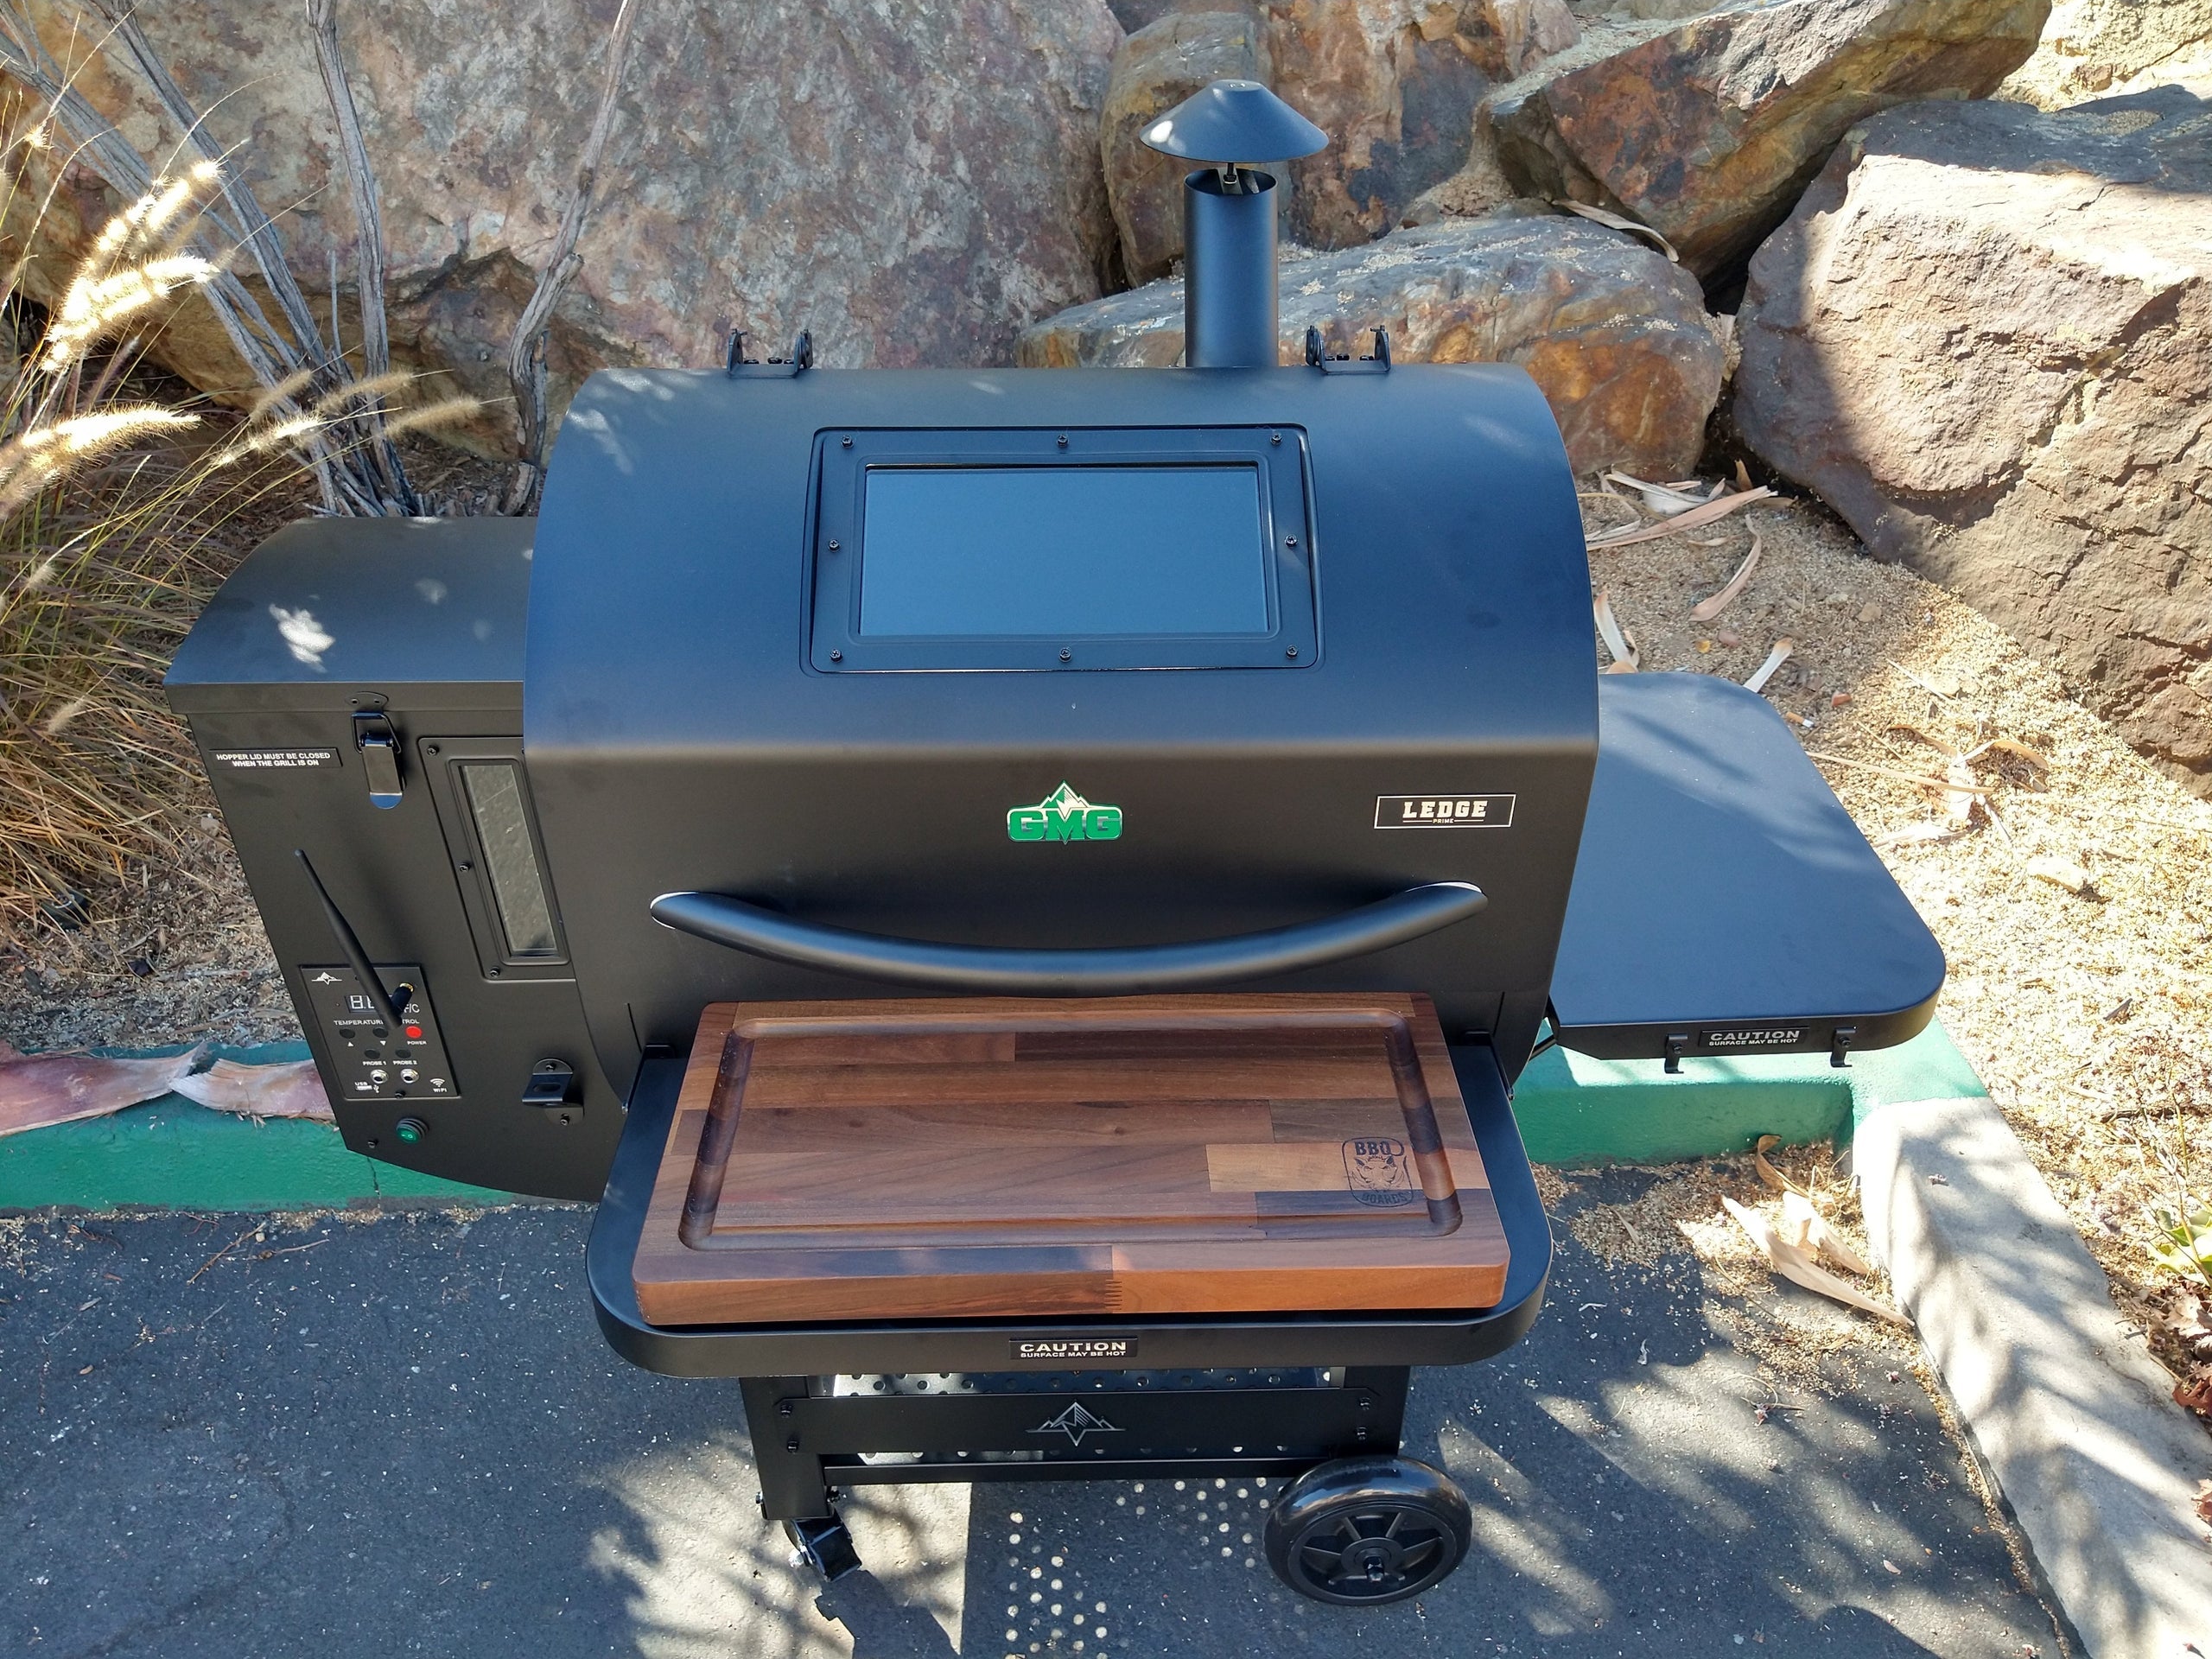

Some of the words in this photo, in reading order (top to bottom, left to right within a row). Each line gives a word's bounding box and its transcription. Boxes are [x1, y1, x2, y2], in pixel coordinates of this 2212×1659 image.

[1402, 800, 1488, 818] LEDGE
[1007, 808, 1122, 843] GMG
[1710, 1031, 1800, 1040] CAUTION
[1354, 1141, 1393, 1156] BBQ
[1361, 1192, 1408, 1204] BOARDS
[1020, 1342, 1127, 1352] CAUTION
